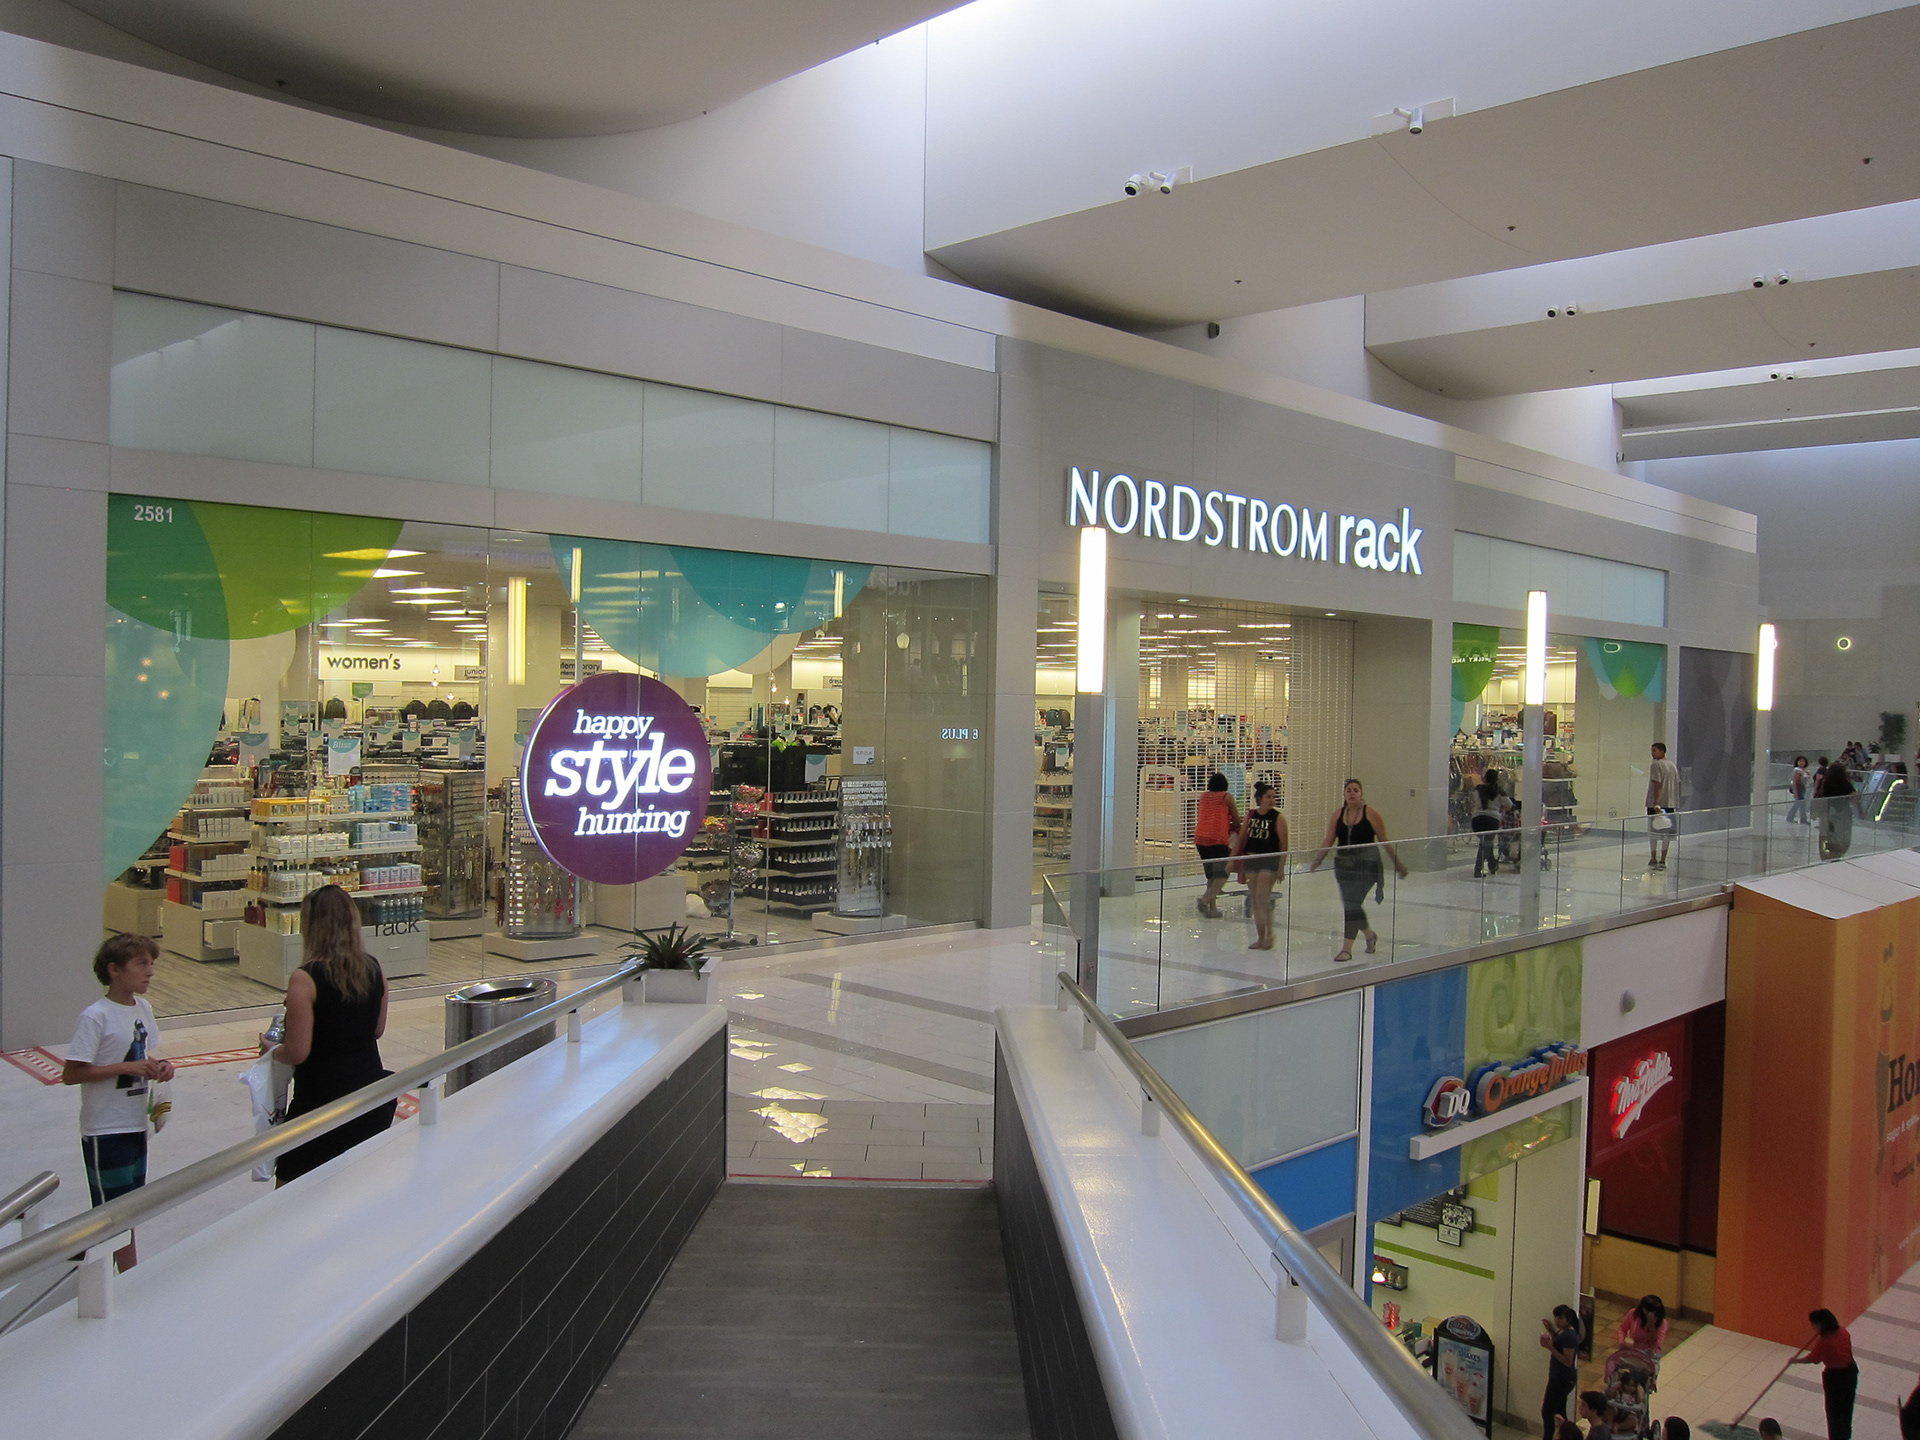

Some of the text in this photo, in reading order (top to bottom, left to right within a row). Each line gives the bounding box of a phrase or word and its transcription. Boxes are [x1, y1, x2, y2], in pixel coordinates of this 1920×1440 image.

[134, 504, 173, 523] 2581
[1069, 466, 1424, 575] NORDSTROM rack
[327, 653, 401, 671] women's
[572, 709, 654, 739] happy
[544, 732, 696, 811] style
[574, 804, 690, 838] hunting
[1250, 818, 1272, 829] RAY
[375, 916, 420, 937] rack
[1480, 1046, 1588, 1113] Orange Julius
[1445, 1087, 1471, 1116] DQ
